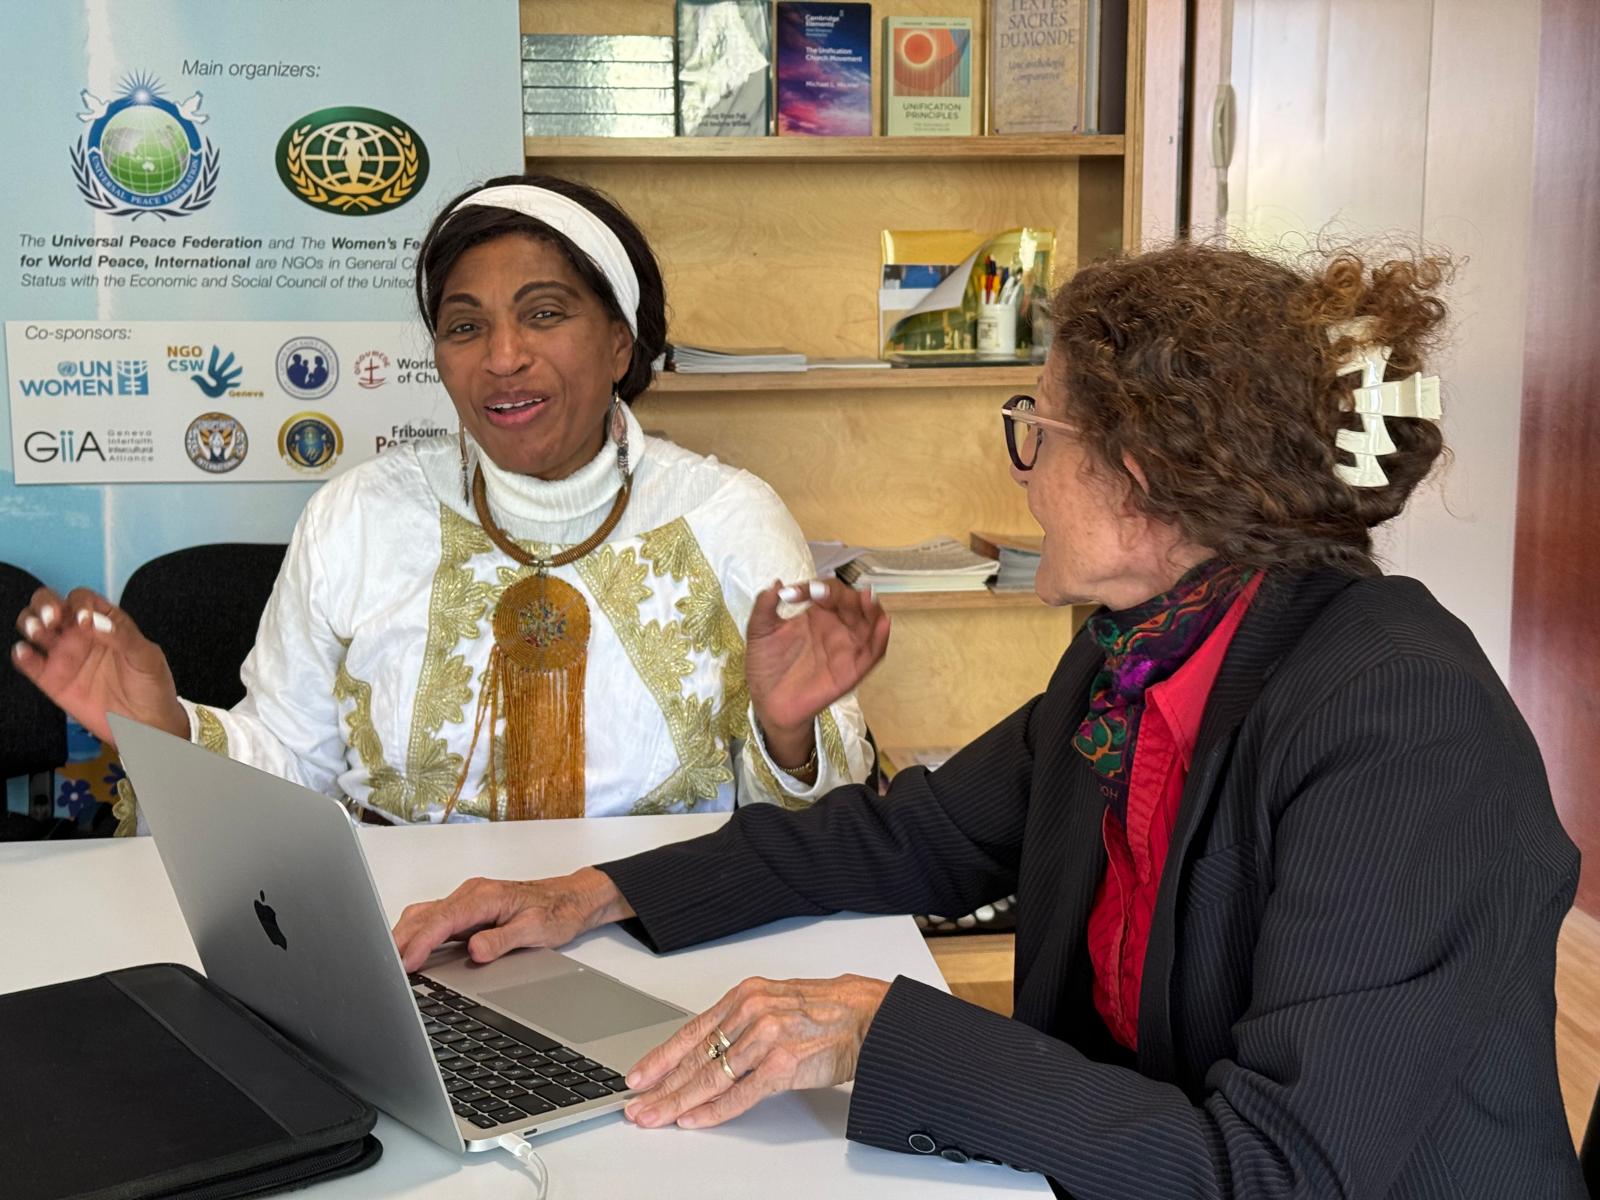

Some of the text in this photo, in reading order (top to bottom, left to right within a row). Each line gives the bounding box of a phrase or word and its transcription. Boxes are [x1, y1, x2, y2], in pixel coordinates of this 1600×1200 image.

[1000, 29, 1077, 48] DU MONDE
[182, 59, 321, 80] Main organizers:
[902, 102, 961, 110] UNIFICATION
[905, 111, 959, 120] PRINCIPLES
[91, 155, 199, 205] UNIVERSAL PEACE FEDERATION
[20, 234, 421, 250] The Universal Peace Federation and The Women's Fe
[20, 254, 43, 268] for
[48, 255, 92, 268] World
[97, 255, 149, 270] Peace,
[154, 256, 251, 269] International
[255, 258, 277, 269] are
[281, 256, 323, 270] NGOs
[328, 256, 340, 269] in
[345, 256, 397, 270] General
[21, 273, 417, 289] Status with the Economic and Social Council of the United
[25, 325, 132, 342] Co-sponsors:
[167, 345, 203, 358] NGO
[79, 360, 112, 377] UN
[167, 359, 205, 372] CSW
[397, 371, 441, 384] of Chu
[19, 379, 114, 397] WOMEN
[228, 390, 264, 398] Geneva
